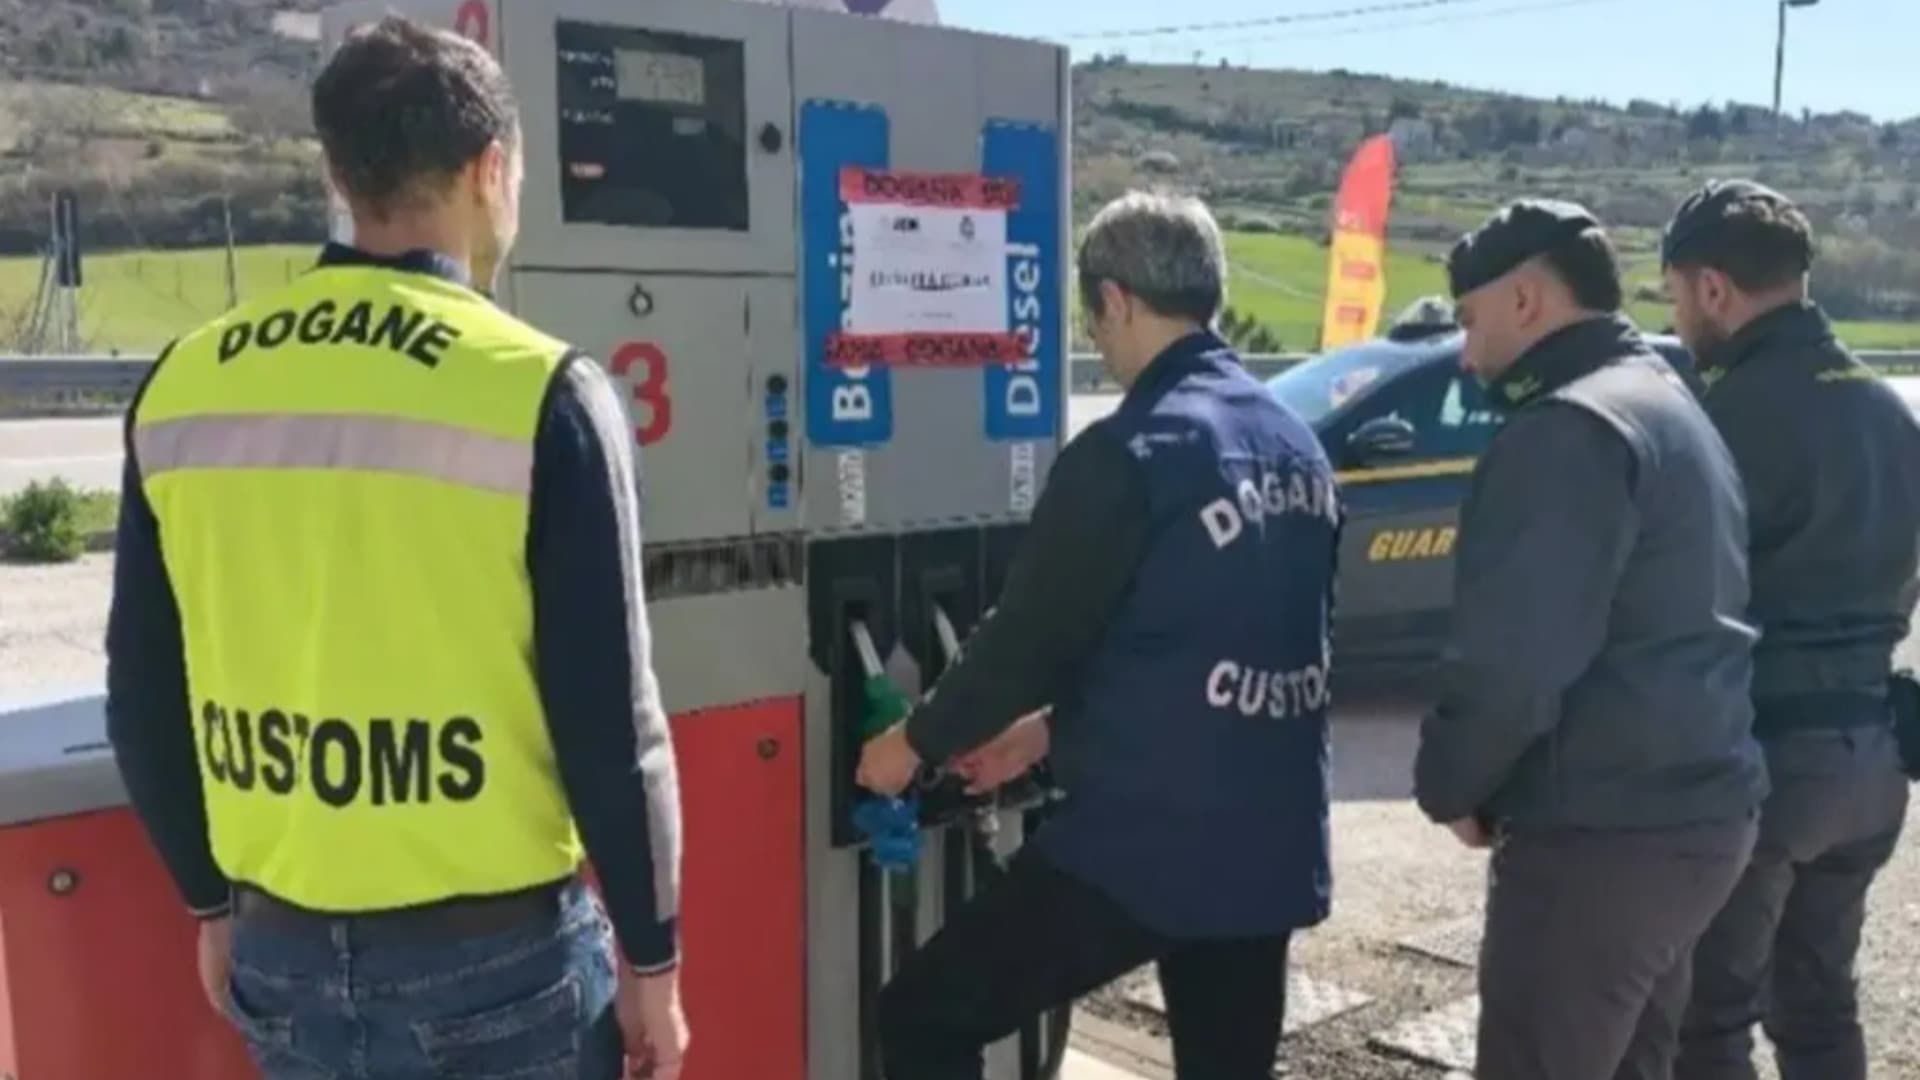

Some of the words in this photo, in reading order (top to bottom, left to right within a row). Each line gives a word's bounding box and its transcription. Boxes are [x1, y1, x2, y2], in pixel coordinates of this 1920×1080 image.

[218, 301, 462, 368] DOGANE
[610, 341, 671, 446] 3
[1200, 471, 1346, 549] DOGAN
[1206, 659, 1331, 718] CUSTO
